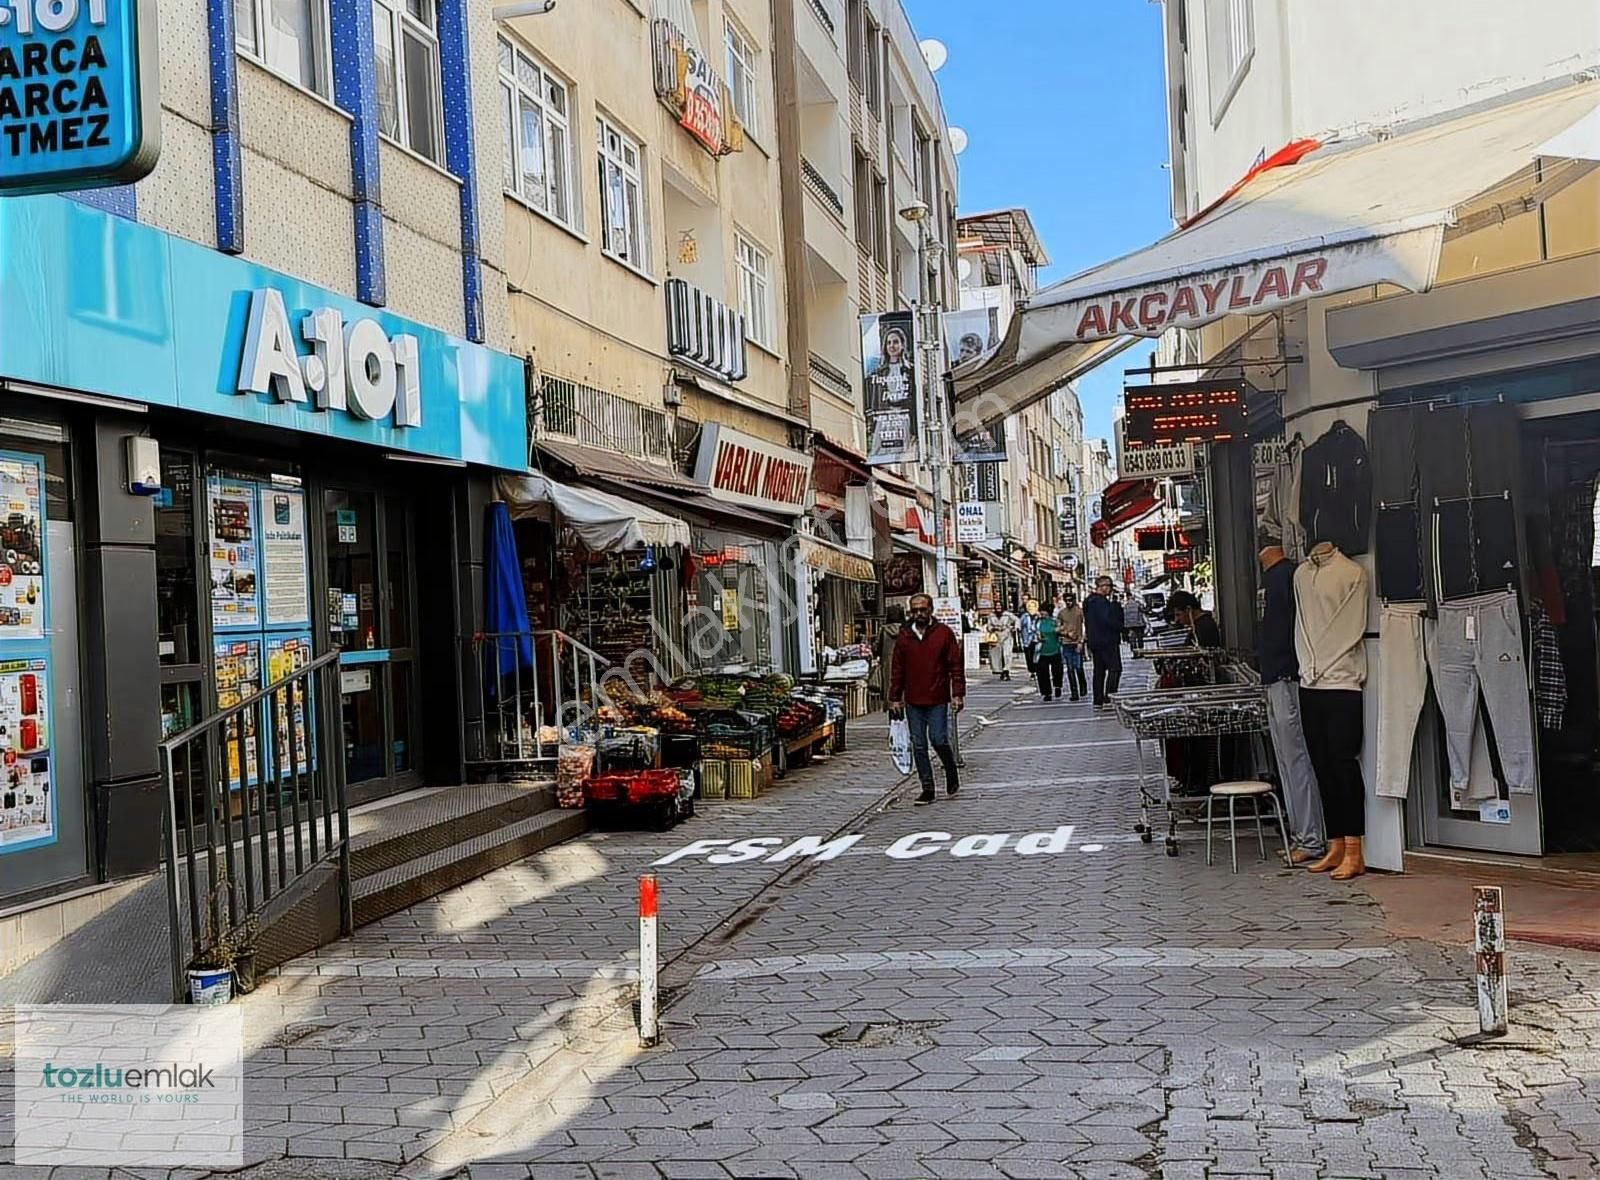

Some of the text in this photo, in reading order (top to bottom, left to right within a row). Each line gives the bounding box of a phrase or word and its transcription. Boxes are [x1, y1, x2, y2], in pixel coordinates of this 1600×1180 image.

[1076, 257, 1328, 339] AKÇAYLAR
[713, 440, 764, 497] VARLIK
[1124, 454, 1143, 473] 0543
[1163, 452, 1173, 468] 03
[1175, 450, 1186, 467] 33
[650, 825, 1104, 866] FSM Cad.
